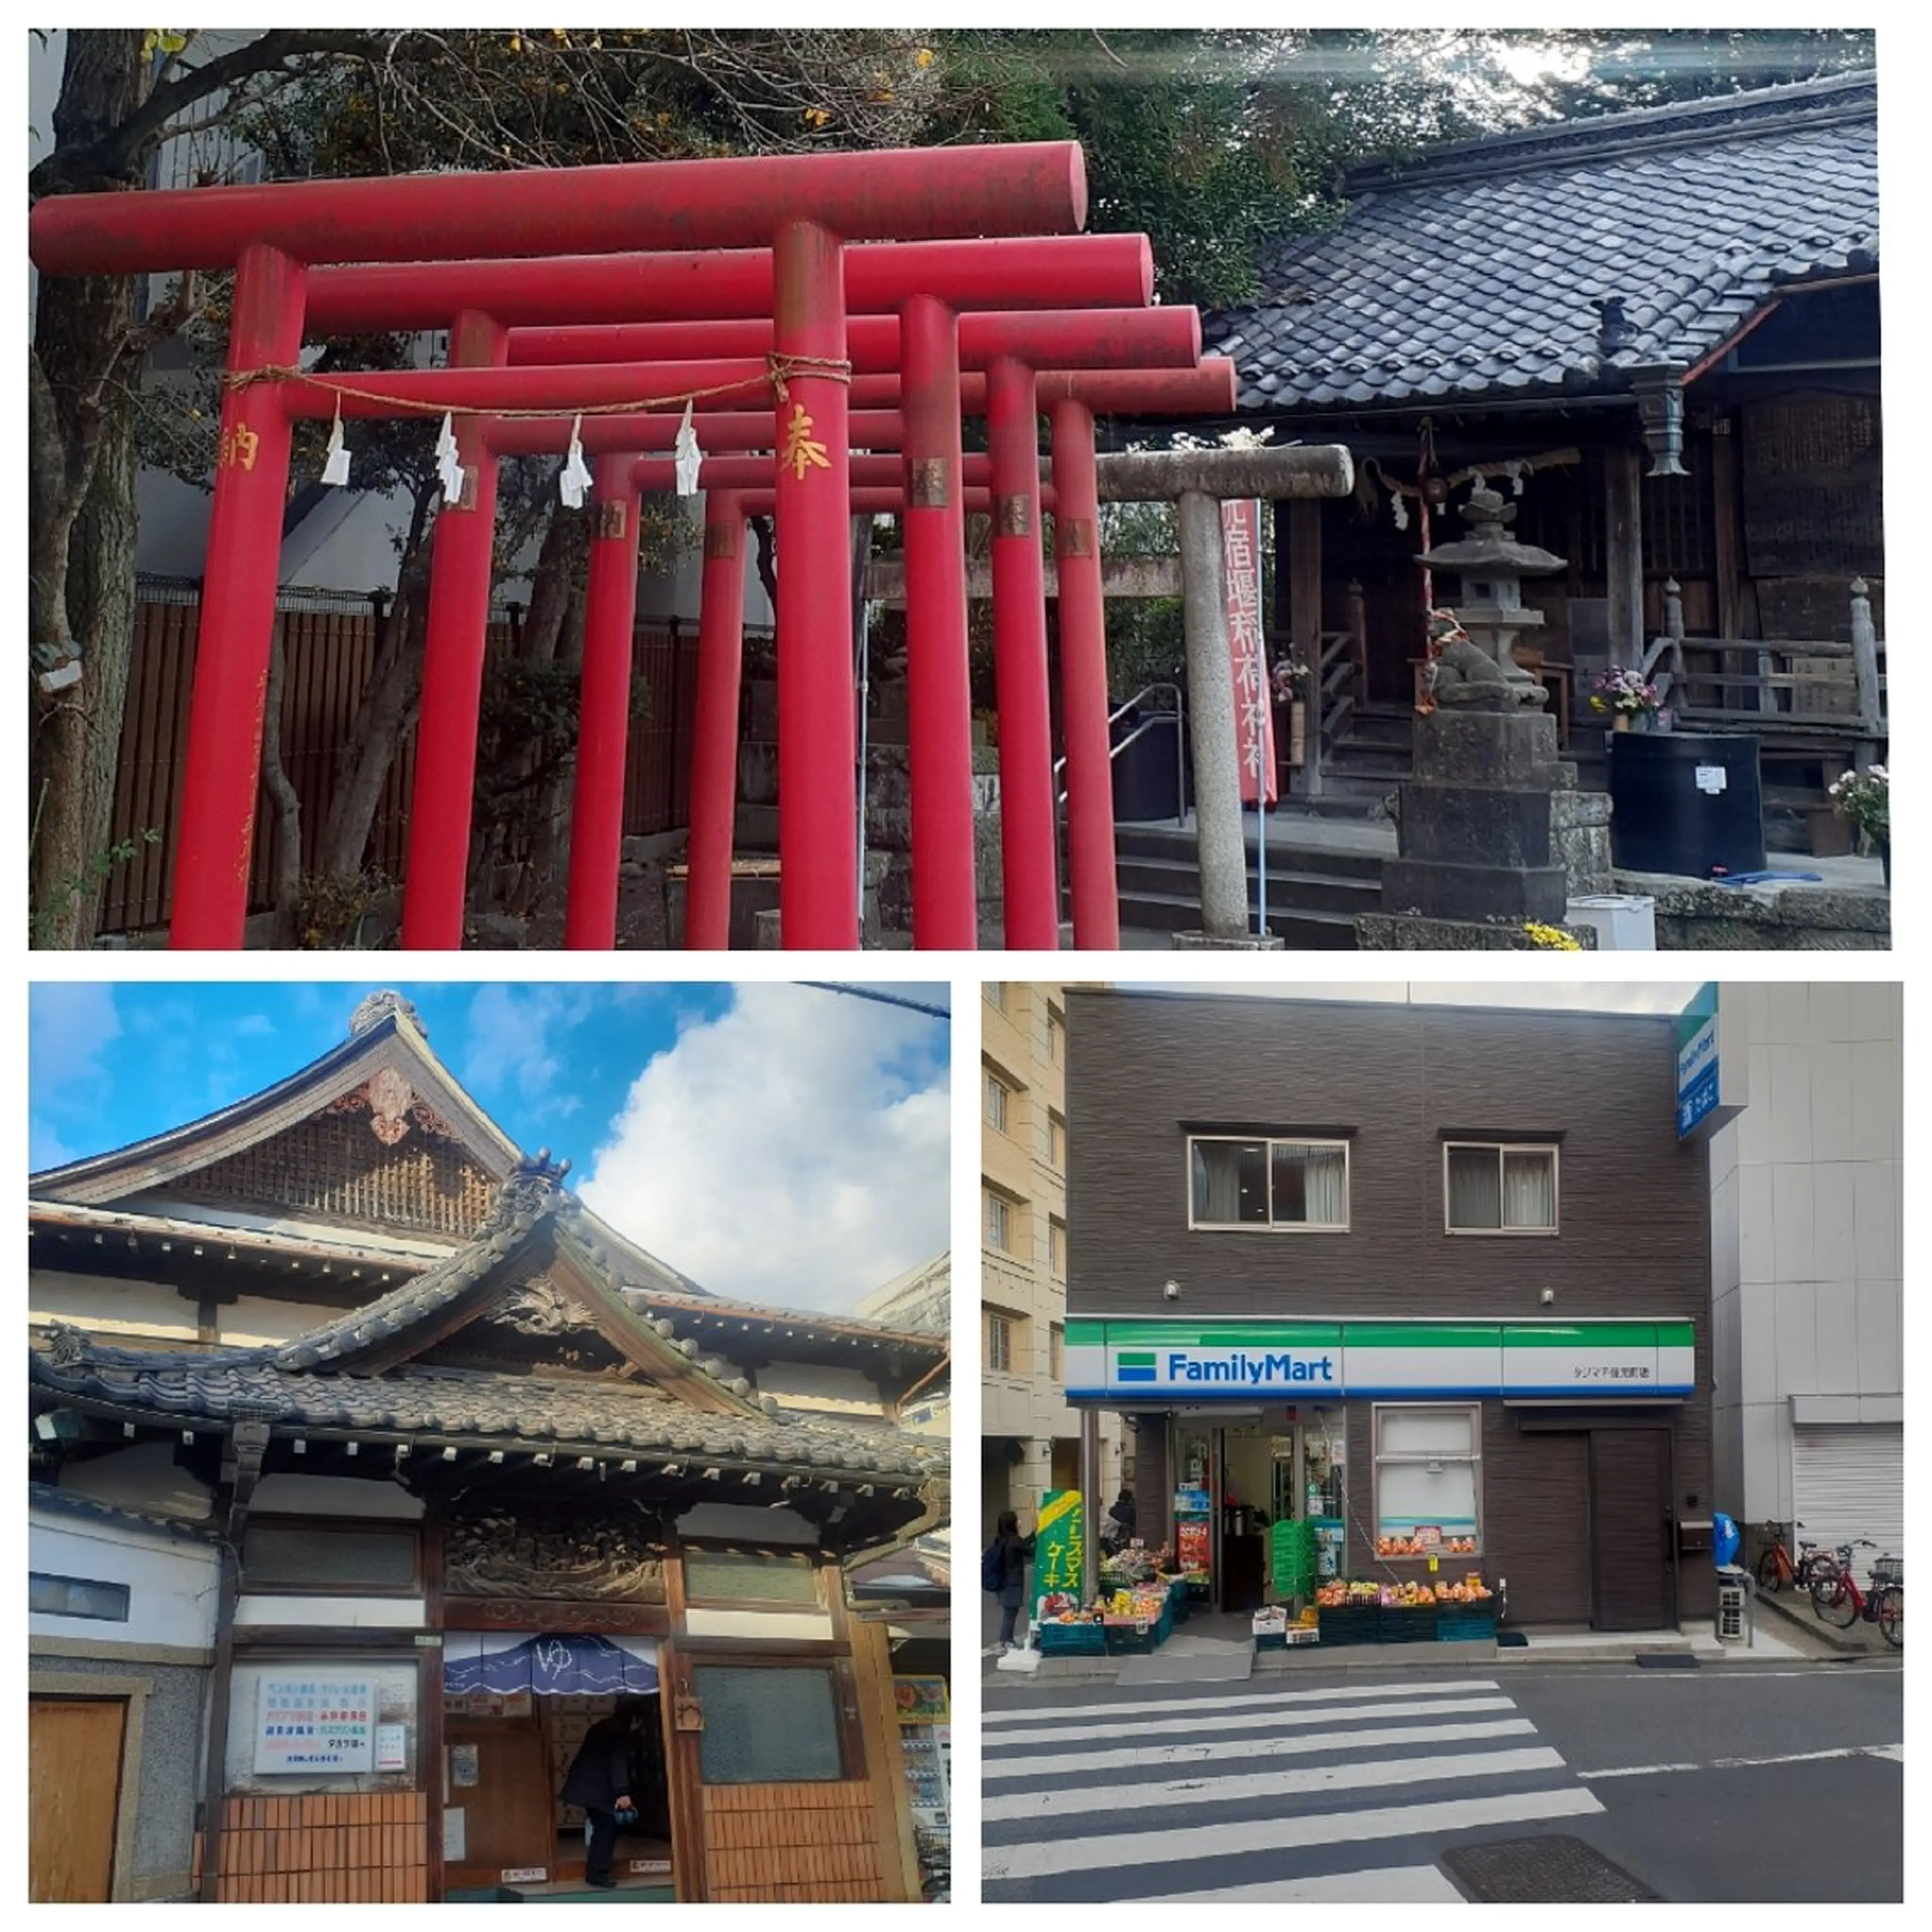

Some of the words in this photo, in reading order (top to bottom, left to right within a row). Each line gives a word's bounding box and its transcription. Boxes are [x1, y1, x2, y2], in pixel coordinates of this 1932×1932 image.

[781, 404, 832, 480] 奉
[1169, 1354, 1333, 1384] FamilyMart
[1043, 1540, 1065, 1588] ケーキ
[536, 1639, 572, 1681] ゆ
